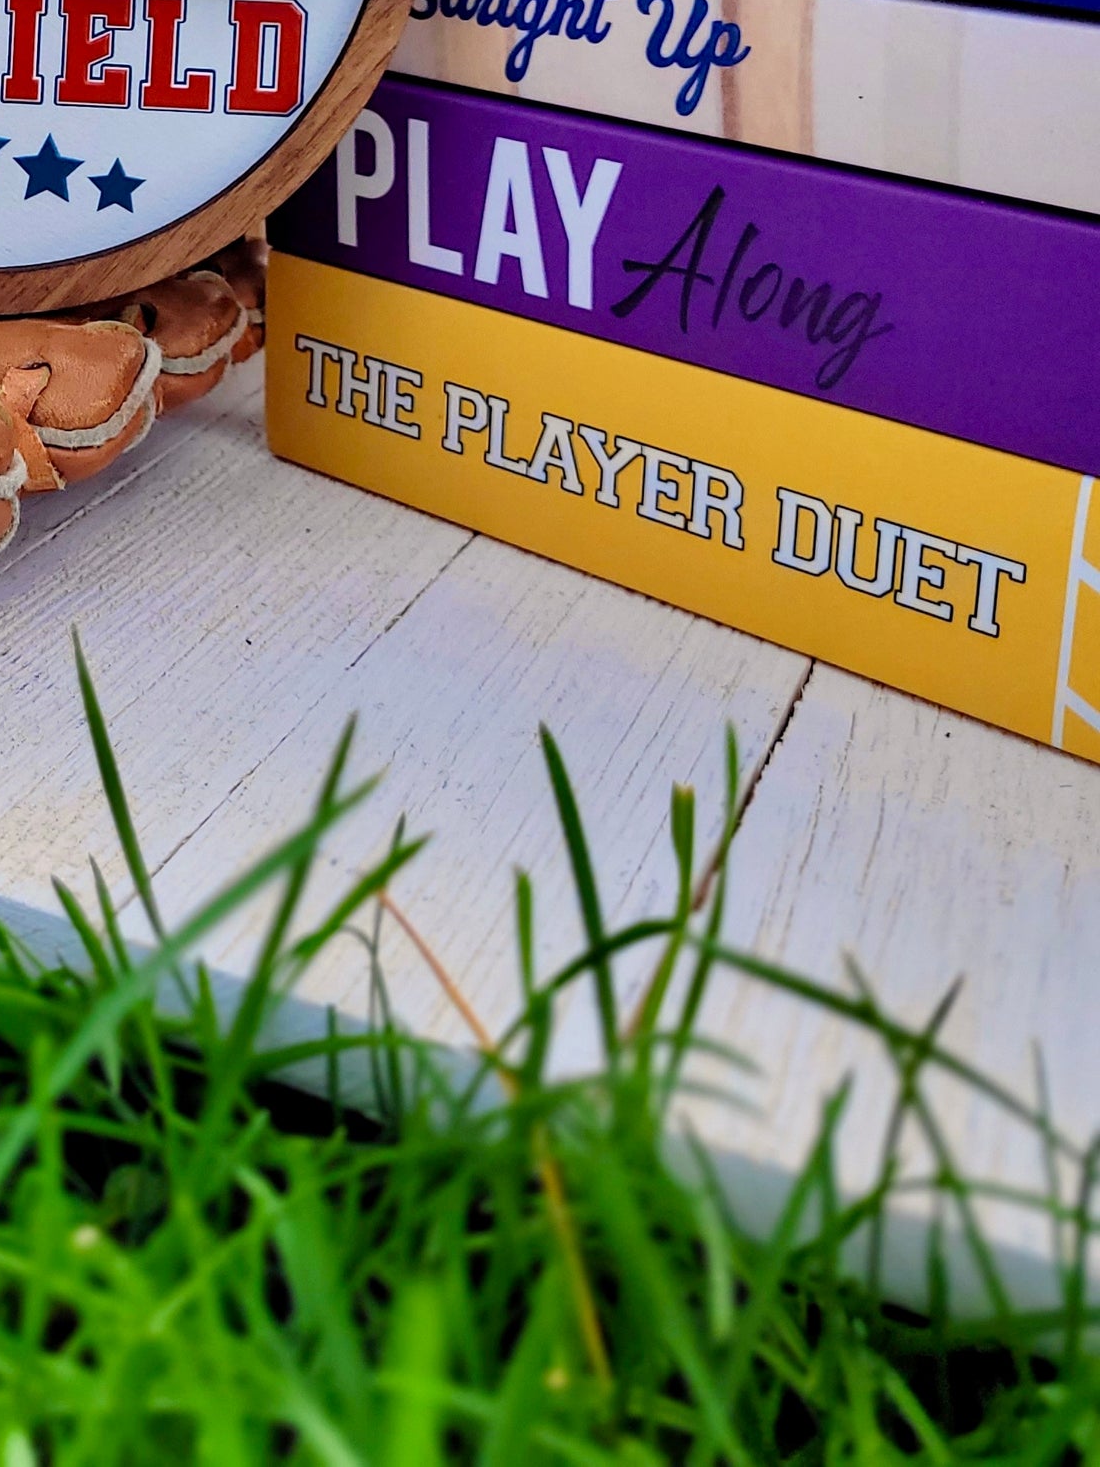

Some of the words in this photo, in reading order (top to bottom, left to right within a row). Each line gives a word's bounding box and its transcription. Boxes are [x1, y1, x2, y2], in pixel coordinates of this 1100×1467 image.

[337, 109, 624, 311] PLAY
[611, 186, 896, 391] Along
[295, 335, 423, 440] THE
[442, 381, 745, 550] PLAYER
[772, 487, 1027, 638] DUET
